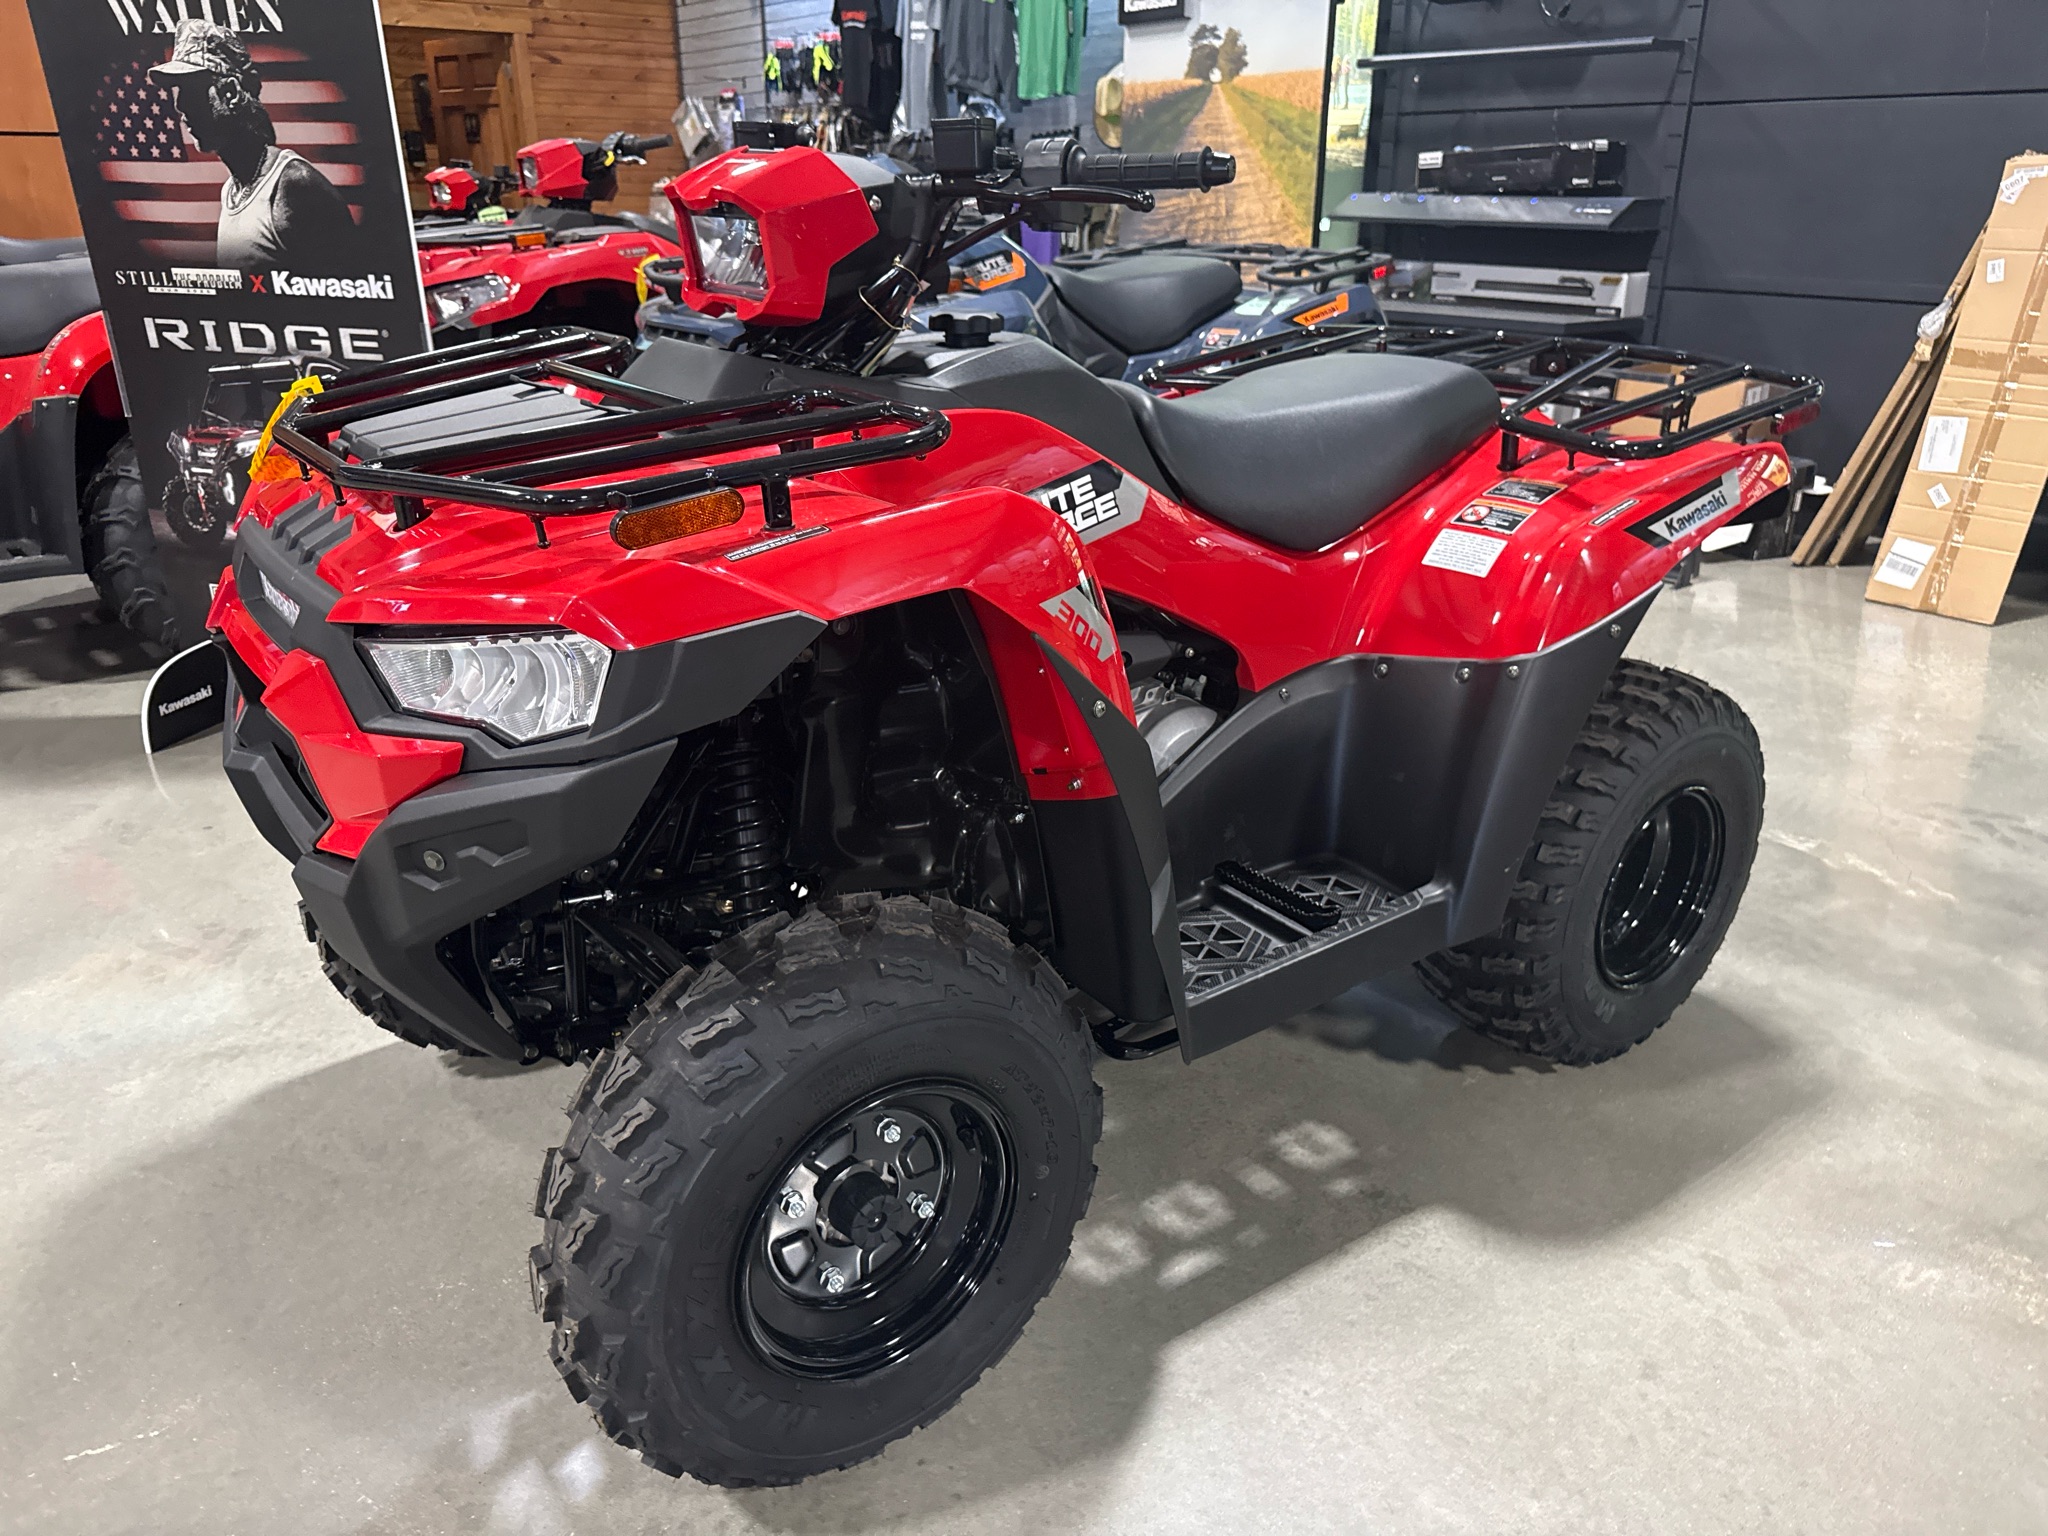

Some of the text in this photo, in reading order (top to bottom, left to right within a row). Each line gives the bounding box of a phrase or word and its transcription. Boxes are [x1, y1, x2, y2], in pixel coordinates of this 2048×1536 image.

[115, 270, 173, 286] STILL
[174, 272, 193, 287] THE
[195, 273, 242, 289] PROBLEM
[270, 270, 394, 299] Kawasaki
[1302, 304, 1339, 323] Kawasaki
[144, 317, 384, 361] RIDGE
[1664, 490, 1728, 538] Kawasaki
[1058, 599, 1102, 657] 300
[158, 684, 213, 717] Kawasaki
